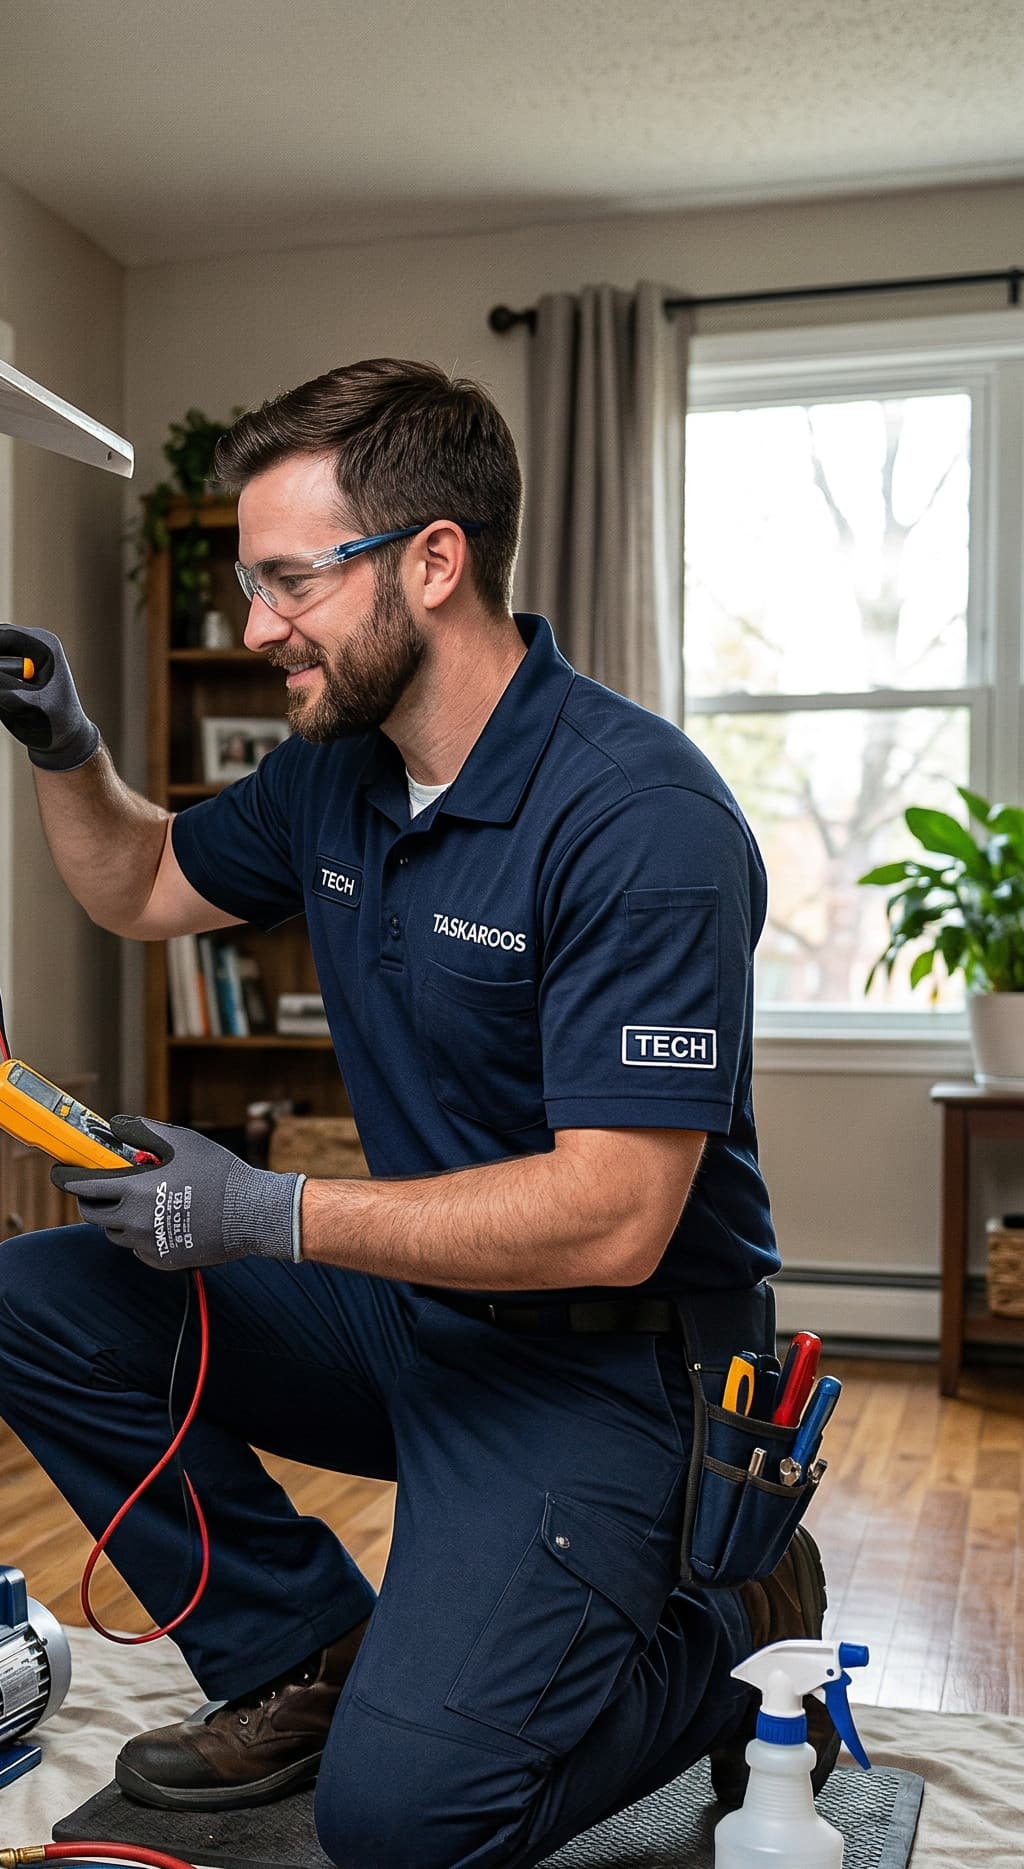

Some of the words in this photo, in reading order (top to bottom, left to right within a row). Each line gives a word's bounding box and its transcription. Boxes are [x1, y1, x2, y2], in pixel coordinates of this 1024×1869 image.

[321, 868, 355, 896] TECH
[433, 913, 526, 953] TASKAROOS
[634, 1034, 707, 1060] TECH
